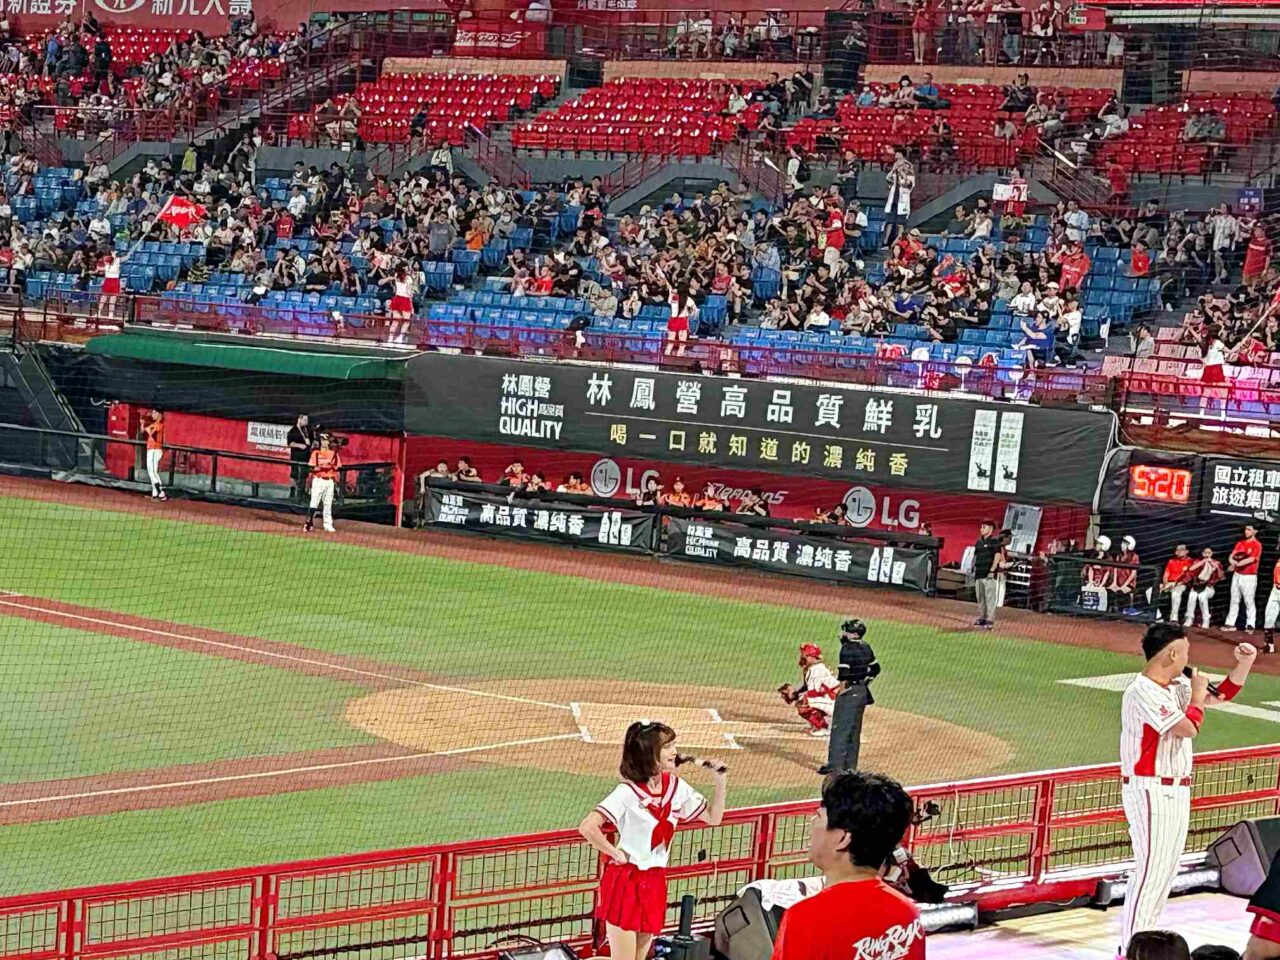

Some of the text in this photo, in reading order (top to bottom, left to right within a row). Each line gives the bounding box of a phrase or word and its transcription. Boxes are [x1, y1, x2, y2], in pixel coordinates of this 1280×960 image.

[502, 373, 551, 398] 林鳳營
[500, 396, 538, 417] HIGH
[586, 372, 943, 440] 林鳳營高品質鮮乳
[499, 416, 563, 440] QUALITY
[610, 423, 908, 477] 喝一口就知道的濃純香
[1133, 464, 1191, 501] 5:20
[1214, 464, 1280, 488] 國立租車
[881, 496, 920, 529] LG
[1211, 486, 1280, 511] 旅遊集團
[480, 504, 585, 536] 高品質 濃純香
[733, 536, 853, 572] 高品質 濃純香
